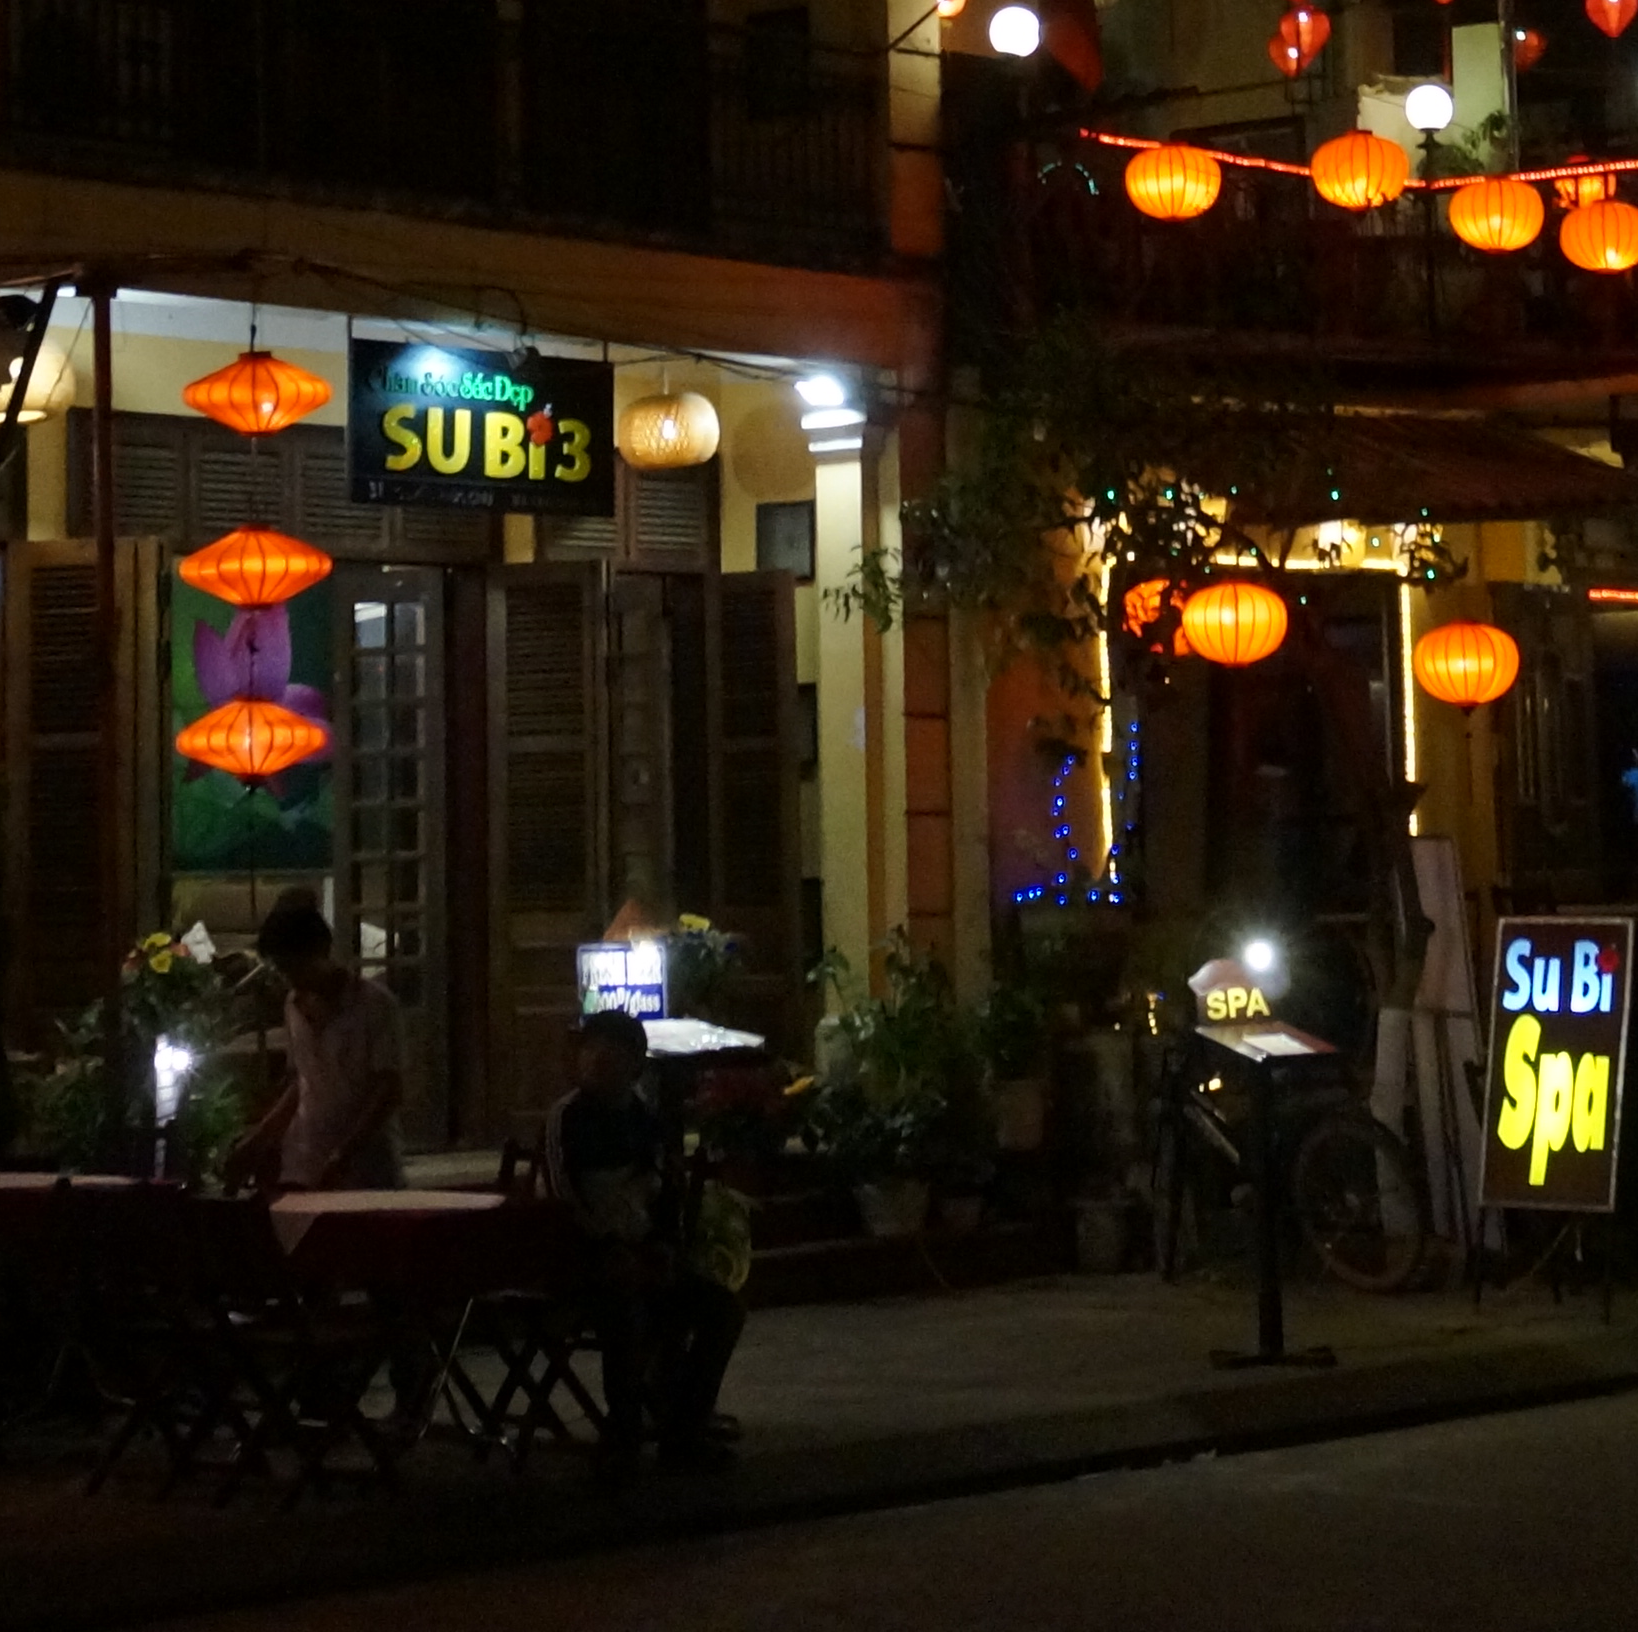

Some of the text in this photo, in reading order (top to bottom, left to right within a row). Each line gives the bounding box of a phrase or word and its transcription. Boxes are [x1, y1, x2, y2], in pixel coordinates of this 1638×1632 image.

[382, 402, 472, 474] SU
[554, 417, 592, 483] 3
[1206, 986, 1271, 1021] SPA
[1501, 937, 1620, 1014] Su Bi
[1497, 1013, 1611, 1187] Spa
